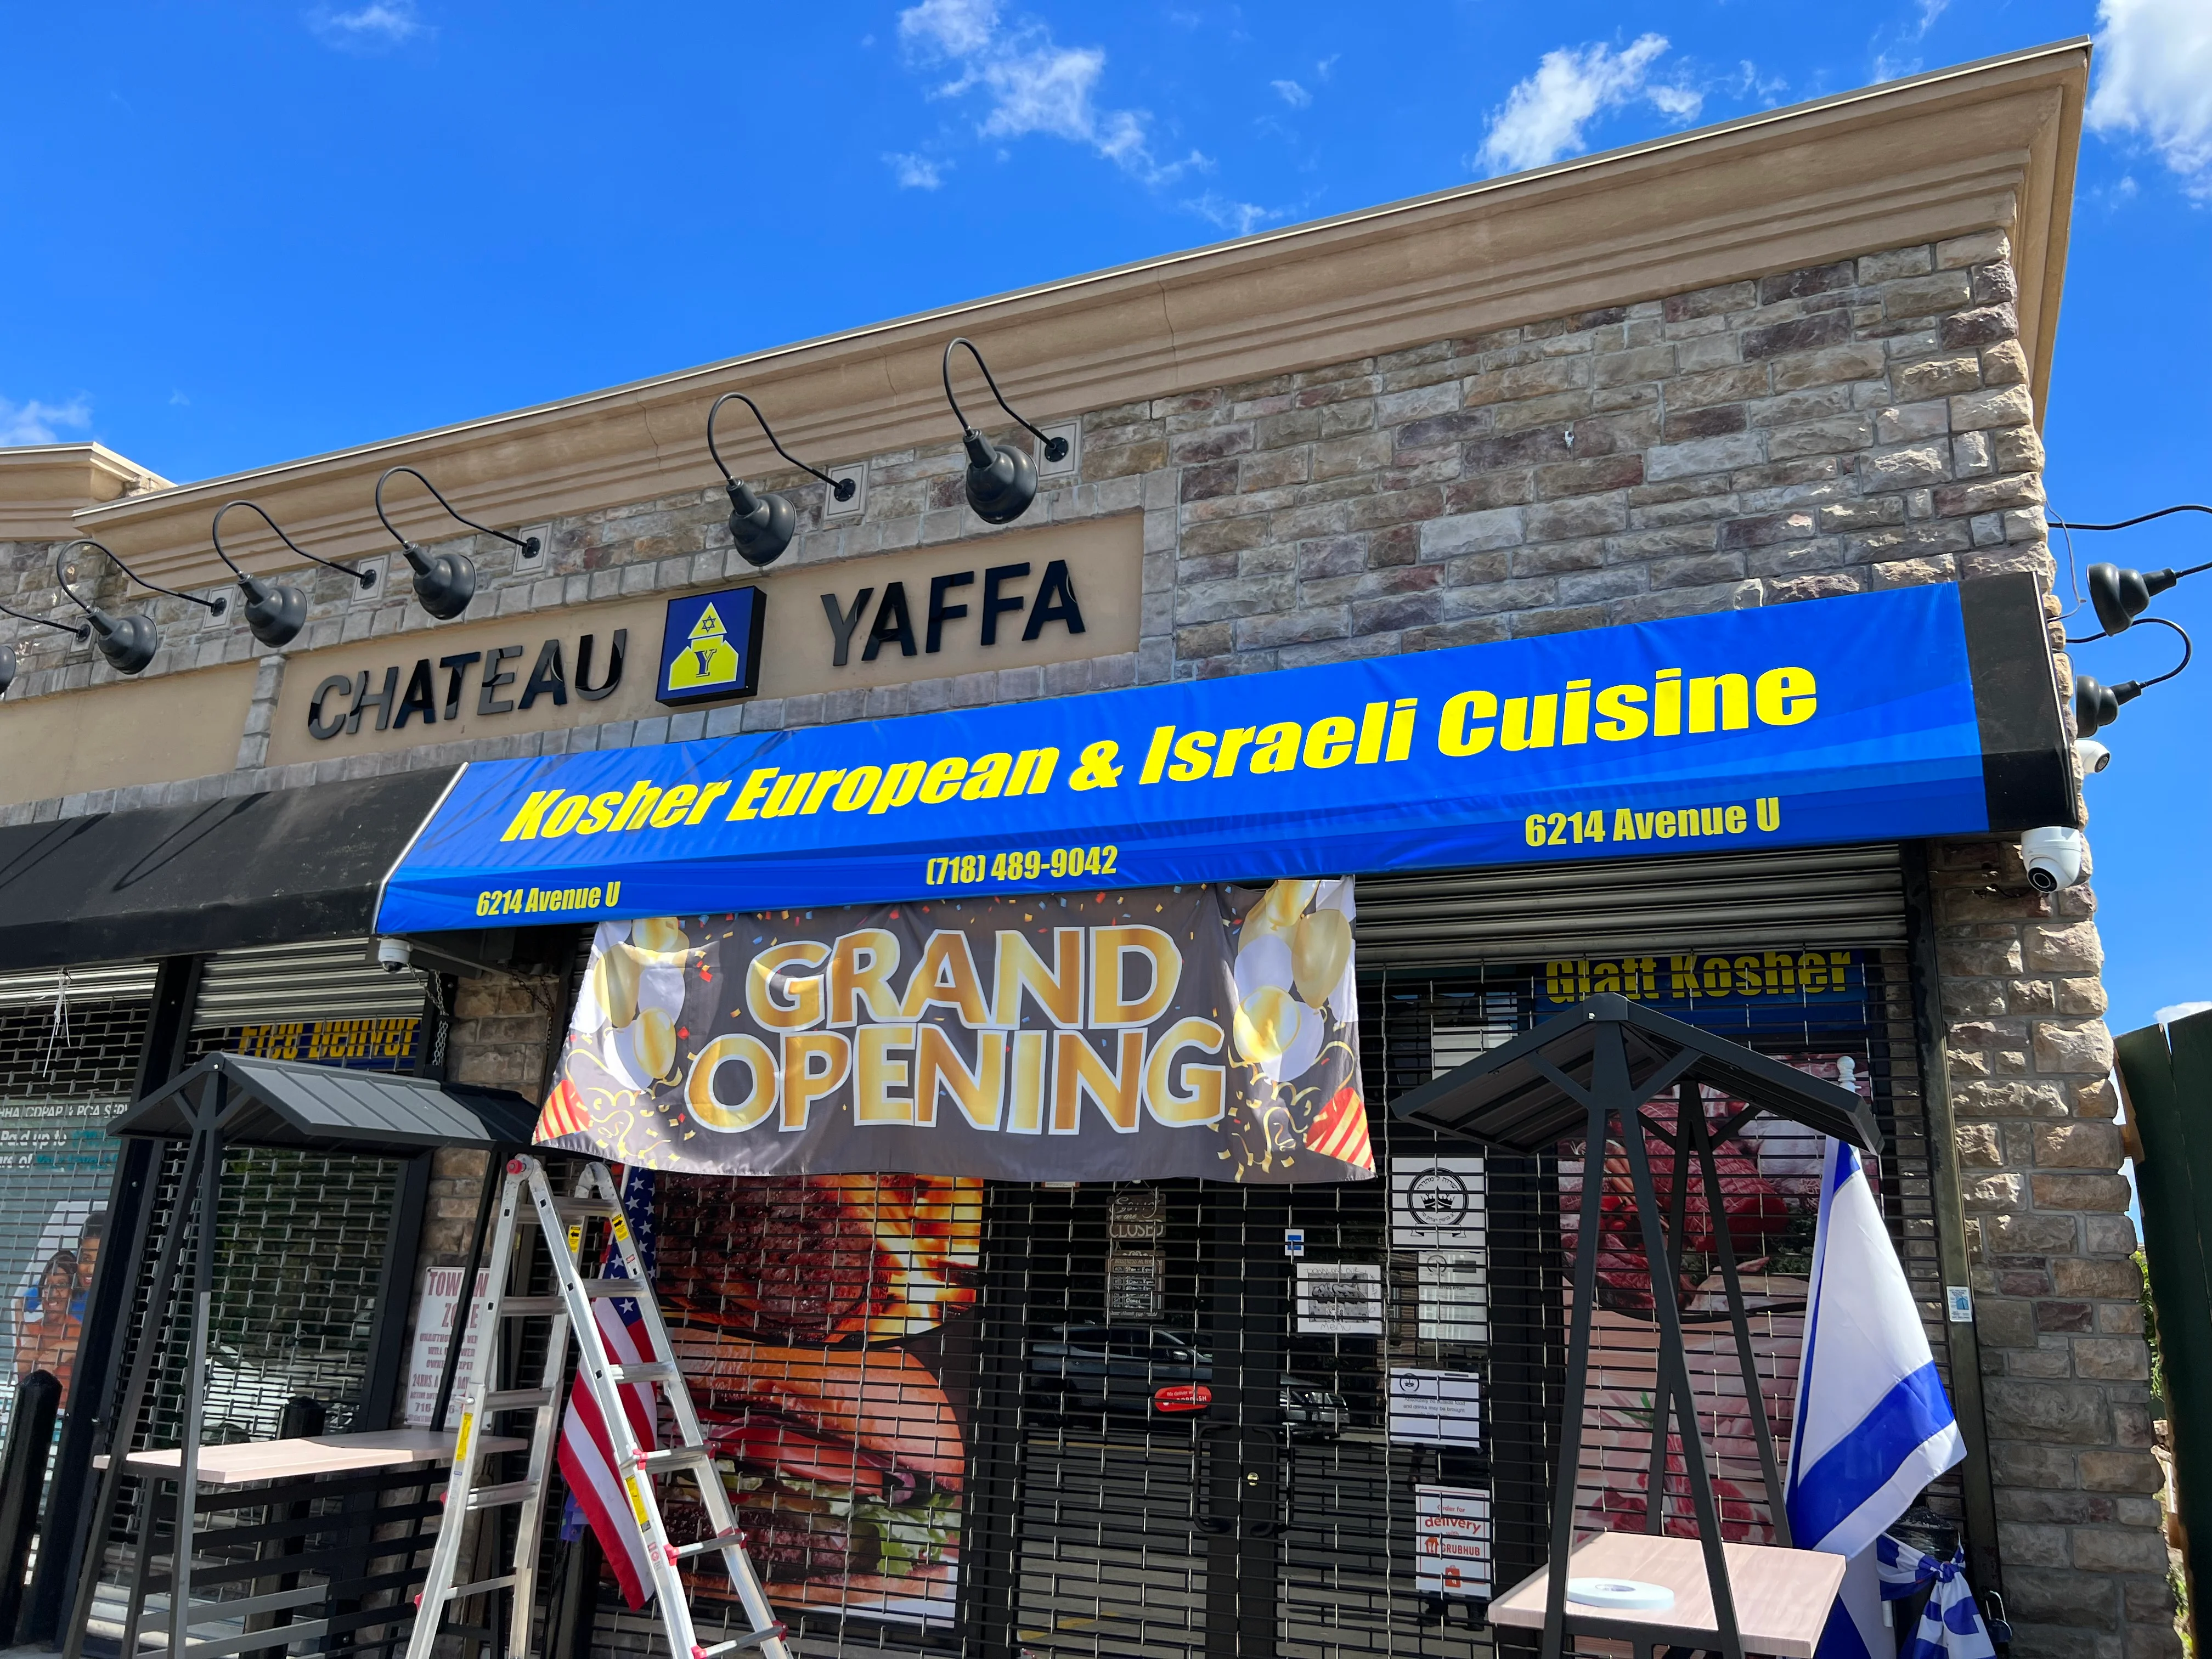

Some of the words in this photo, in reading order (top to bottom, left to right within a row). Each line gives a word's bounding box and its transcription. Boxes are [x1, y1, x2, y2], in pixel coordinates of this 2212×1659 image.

[308, 628, 628, 741] CHATEAU
[820, 559, 1086, 666] YAFFA
[500, 780, 728, 842] Kosher
[725, 746, 1061, 822] European
[1068, 739, 1124, 792] &
[1138, 697, 1419, 785] Israeli
[1437, 665, 1818, 758] Cuisine
[1524, 810, 1606, 847] 6214
[1612, 800, 1748, 842] Avenue
[1755, 797, 1781, 833] U
[926, 851, 986, 885] (718)
[990, 845, 1118, 881] 489-9042
[476, 889, 522, 917] 6214
[525, 884, 602, 913] Avenue
[605, 881, 621, 907] U
[747, 925, 1184, 1031] GRAND
[1546, 957, 1659, 1003] Glatt
[1671, 951, 1851, 998] Kosher
[685, 1017, 1227, 1136] OPENING
[1109, 1219, 1164, 1238] CLOSED
[428, 1271, 462, 1296] TOW
[441, 1302, 479, 1329] ZE
[1424, 1516, 1481, 1534] delivery
